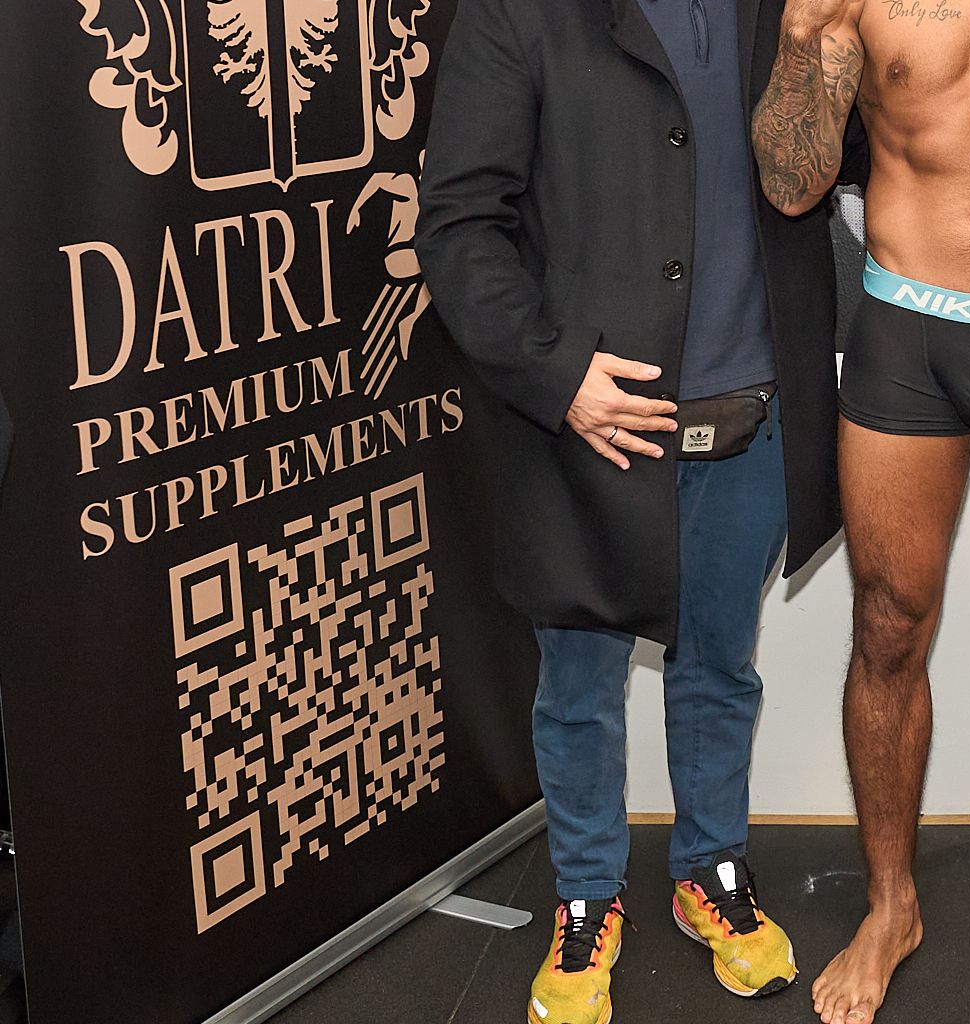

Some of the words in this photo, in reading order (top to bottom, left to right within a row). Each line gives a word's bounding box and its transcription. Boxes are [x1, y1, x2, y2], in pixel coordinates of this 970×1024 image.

[881, 0, 926, 27] Only
[929, 0, 962, 22] Love
[58, 199, 341, 391] DATRI
[72, 348, 354, 476] PREMIUM
[79, 386, 464, 561] SUPPLEMENTS
